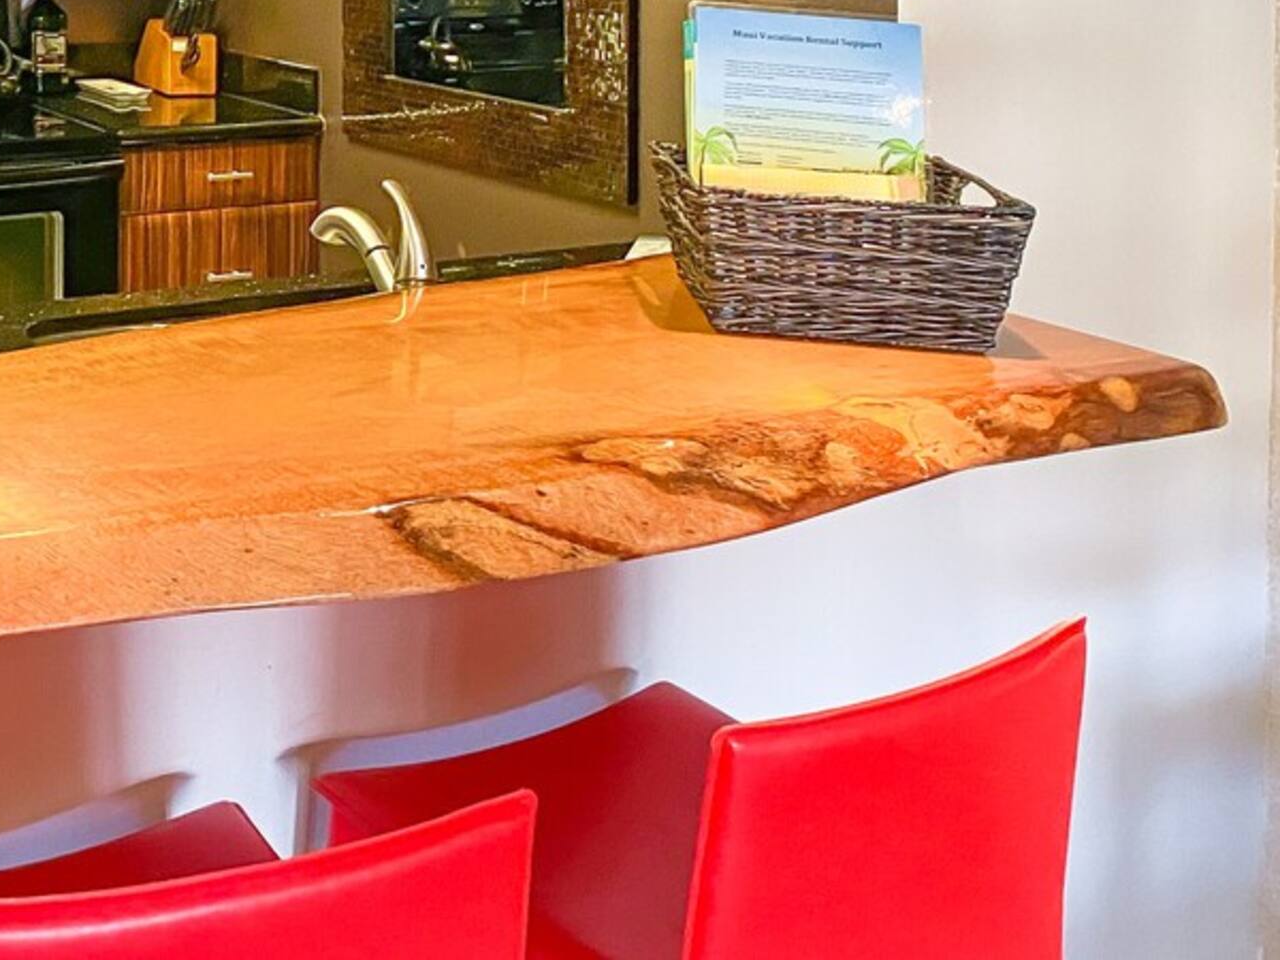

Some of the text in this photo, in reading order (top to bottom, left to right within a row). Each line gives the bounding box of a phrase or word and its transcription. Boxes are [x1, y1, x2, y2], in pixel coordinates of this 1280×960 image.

[732, 29, 882, 50] Maui Vacation Rental Support
